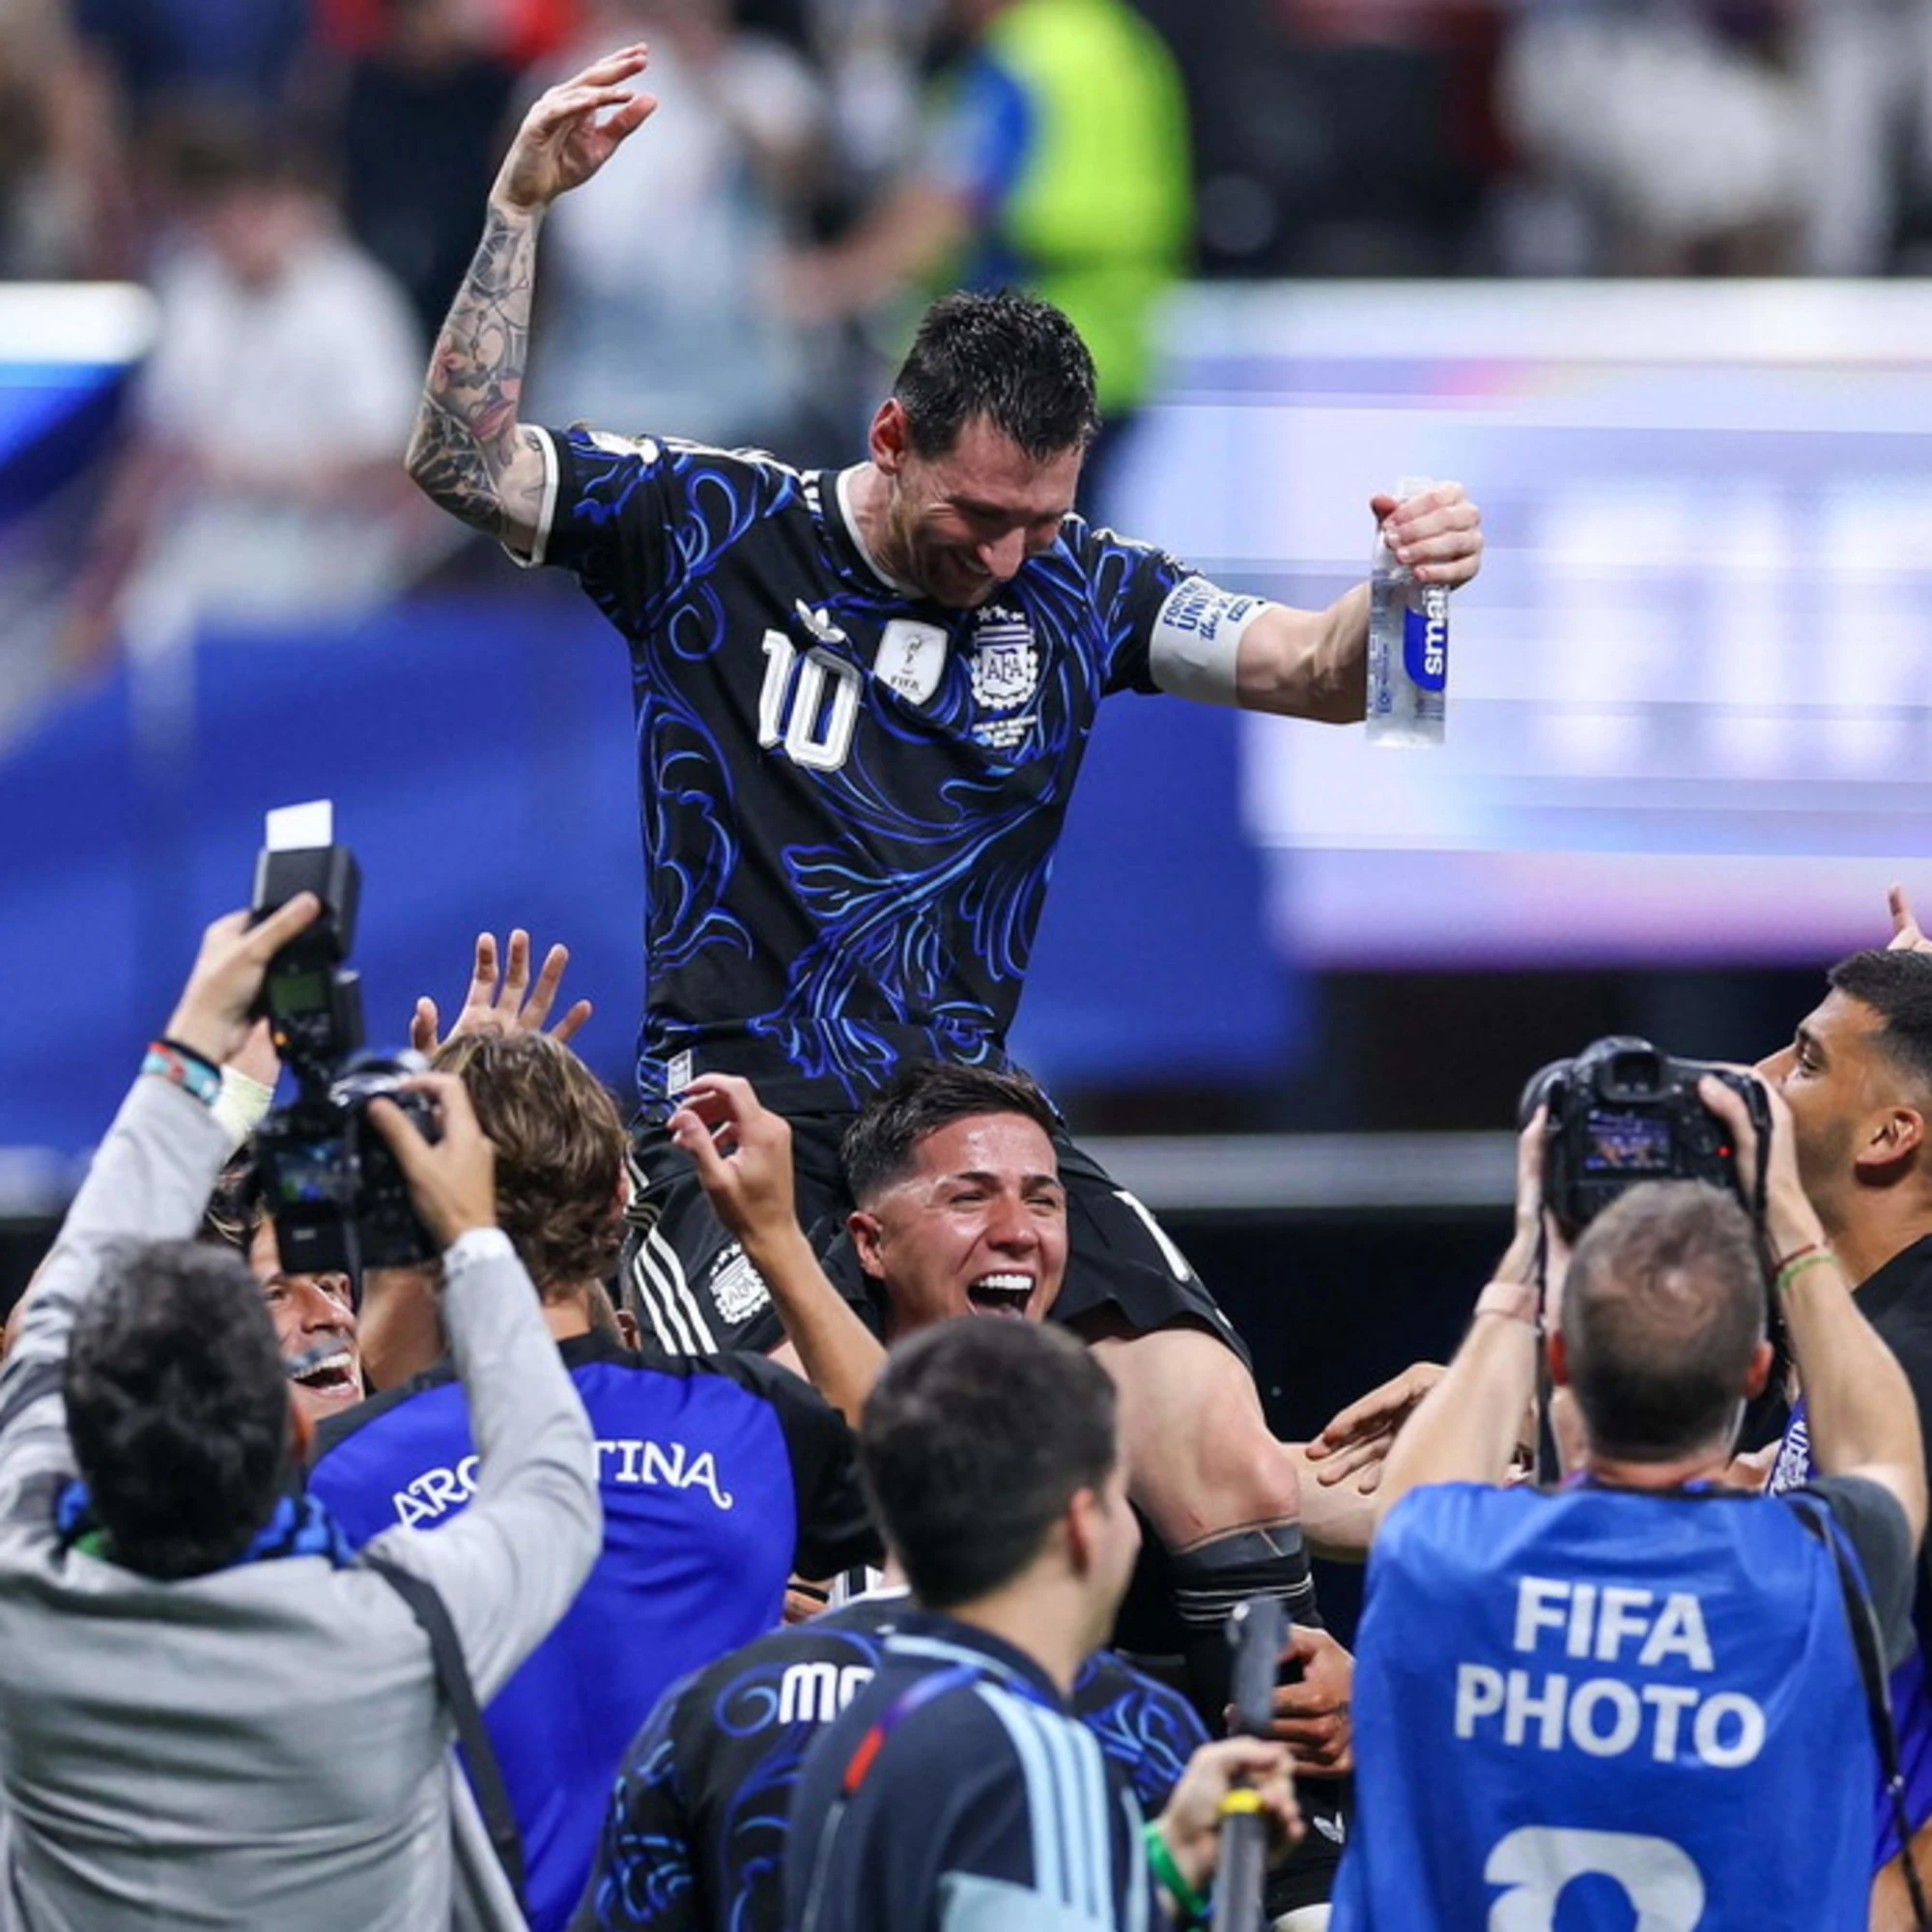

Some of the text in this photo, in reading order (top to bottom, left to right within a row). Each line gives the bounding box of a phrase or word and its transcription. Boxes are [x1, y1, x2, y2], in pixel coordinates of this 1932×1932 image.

[758, 628, 862, 772] 10
[890, 675, 920, 691] FIFA
[985, 647, 1024, 685] AFA
[391, 1440, 733, 1529] ARTINA
[1514, 1576, 1715, 1670] FIFA
[1455, 1662, 1766, 1769] PHOTO
